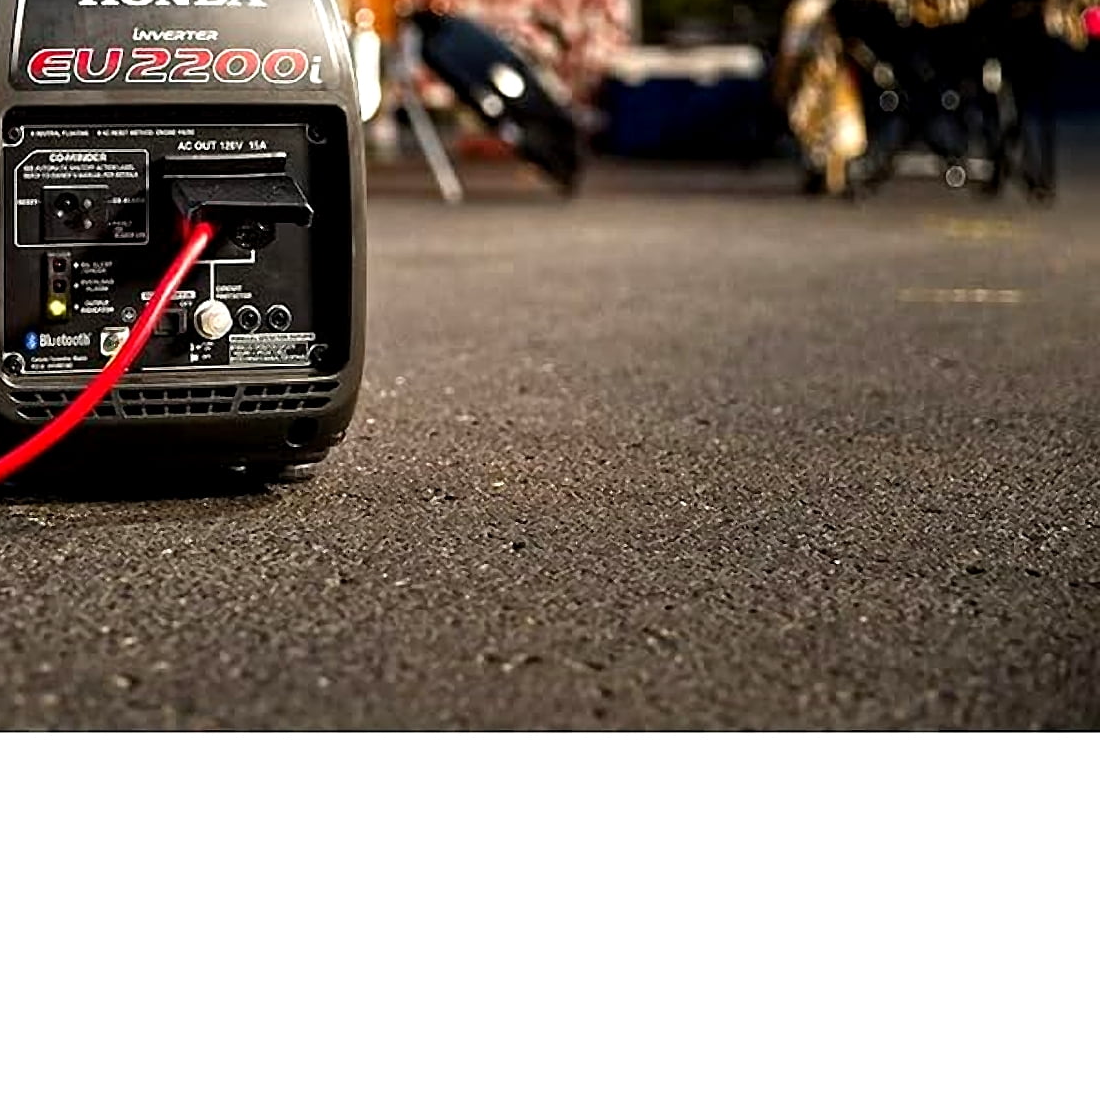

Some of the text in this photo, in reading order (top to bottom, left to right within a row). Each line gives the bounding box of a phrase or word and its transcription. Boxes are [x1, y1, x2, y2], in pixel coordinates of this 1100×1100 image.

[177, 140, 192, 151] AC
[194, 140, 217, 151] OUT
[39, 333, 91, 348] Bluetooth
